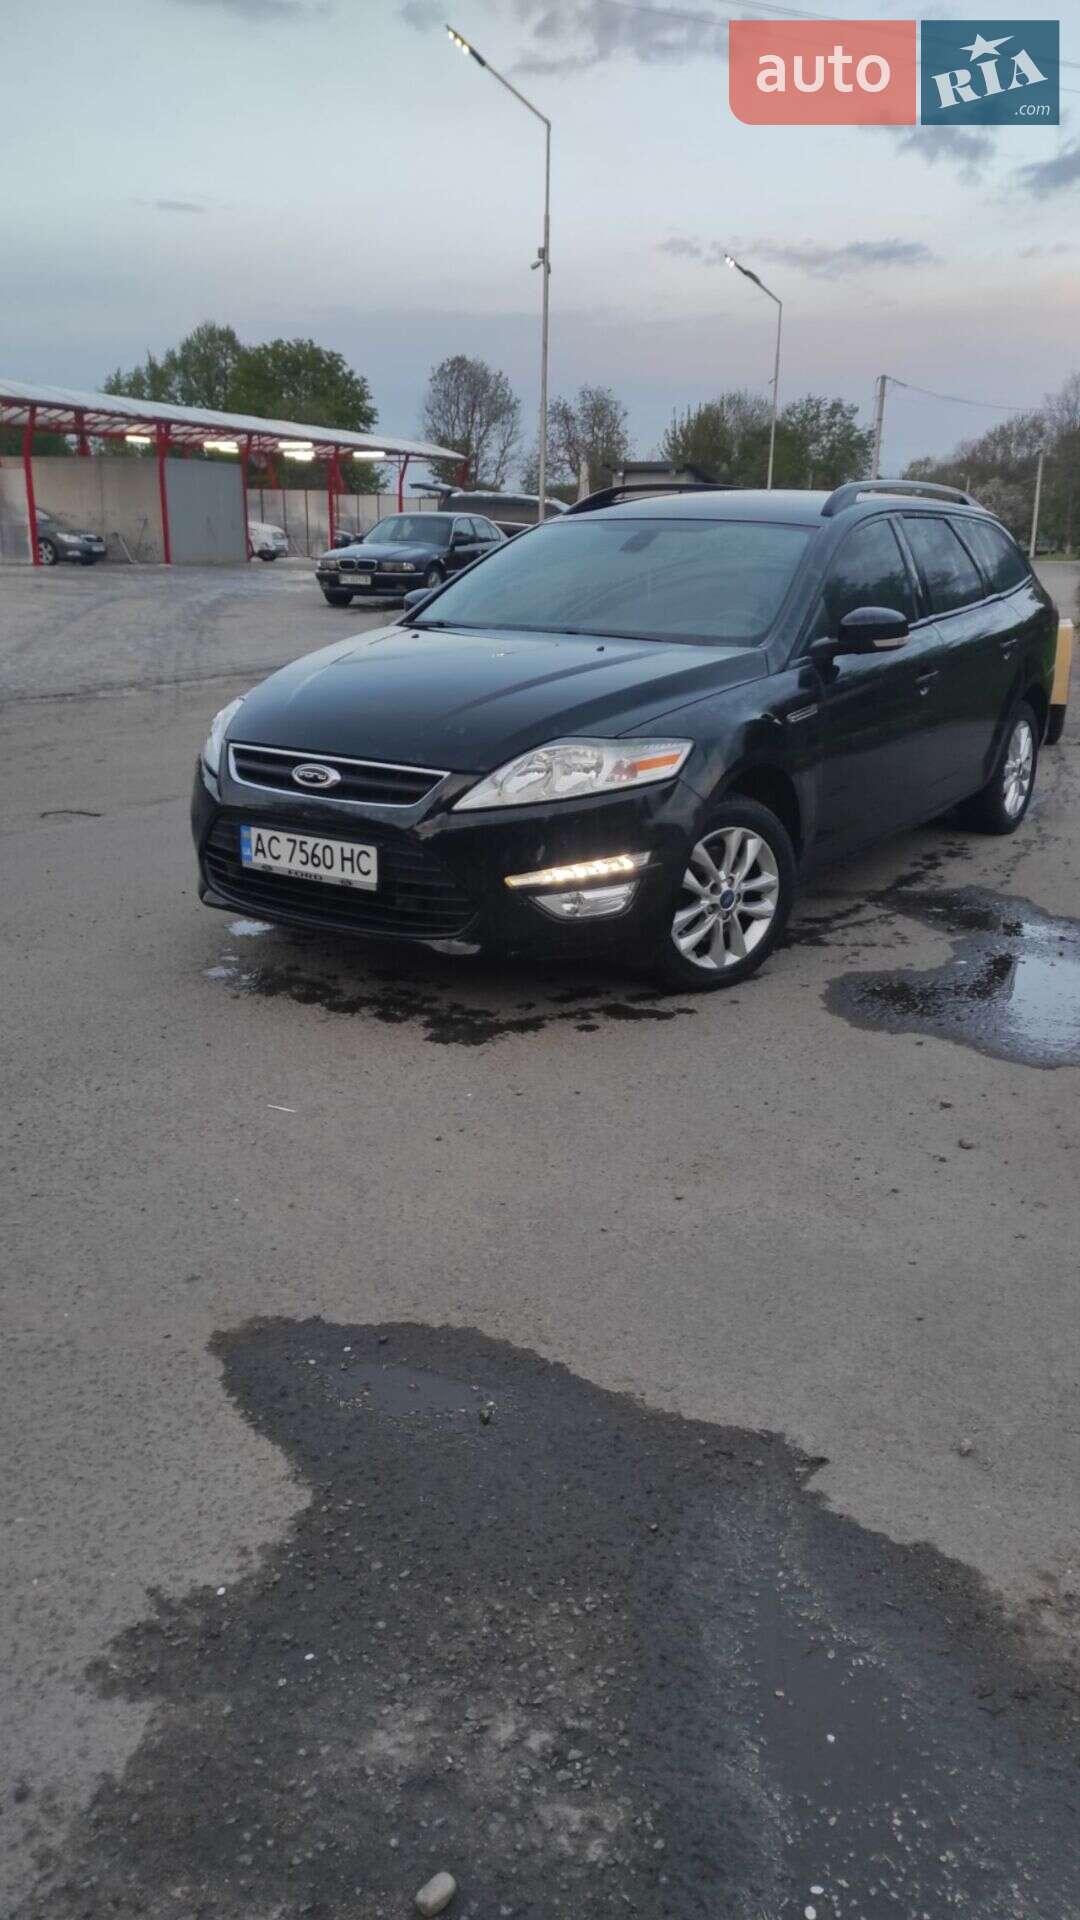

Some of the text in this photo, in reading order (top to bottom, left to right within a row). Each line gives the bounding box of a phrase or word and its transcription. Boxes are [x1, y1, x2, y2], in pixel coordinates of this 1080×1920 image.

[254, 833, 282, 860] AC
[286, 838, 335, 870] 7560
[341, 846, 372, 876] HC
